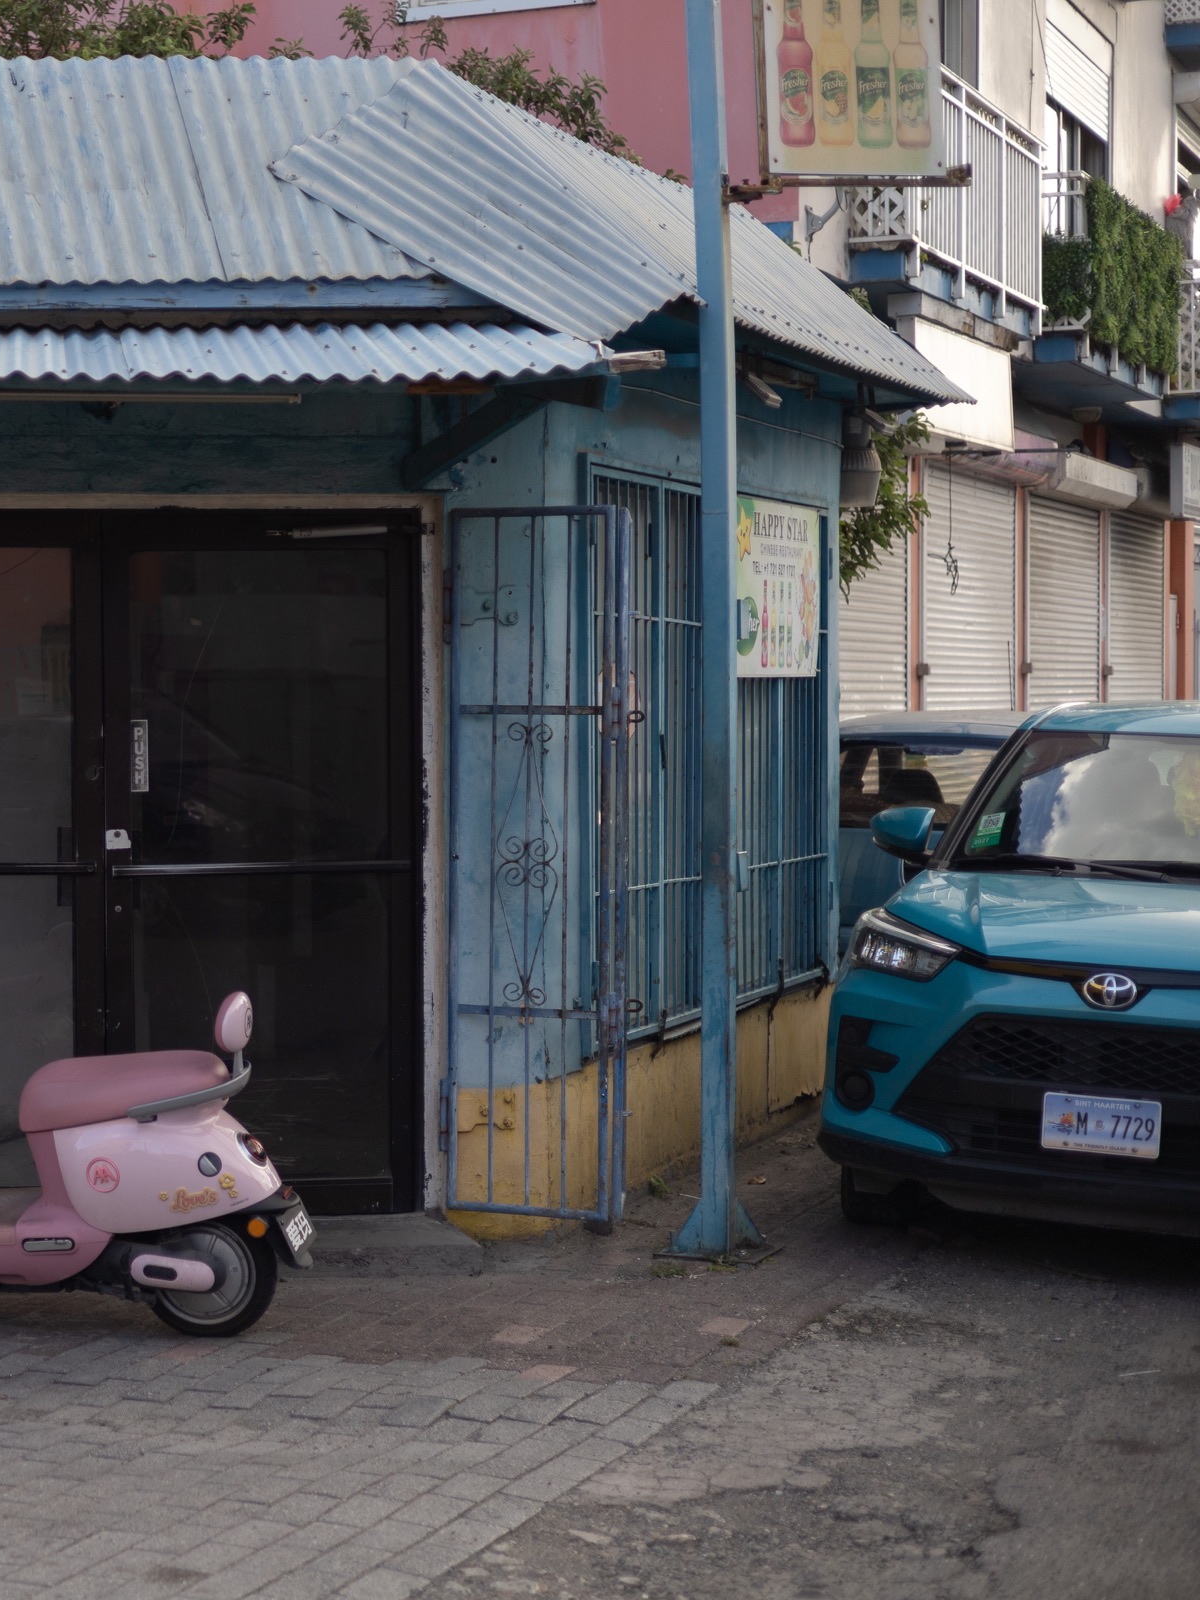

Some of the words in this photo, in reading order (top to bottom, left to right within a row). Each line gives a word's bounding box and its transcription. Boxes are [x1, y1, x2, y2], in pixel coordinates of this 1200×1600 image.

[781, 75, 810, 90] Fresher
[820, 76, 848, 90] Fresher
[859, 77, 887, 93] Fresher
[898, 79, 926, 93] Fresher
[753, 512, 785, 539] HAPPY
[787, 517, 808, 542] STAR
[133, 727, 145, 785] PUSH
[1094, 1102, 1131, 1110] MAARTEN
[1077, 1112, 1088, 1135] M
[1111, 1114, 1155, 1141] 7729
[171, 1187, 218, 1213] Love's
